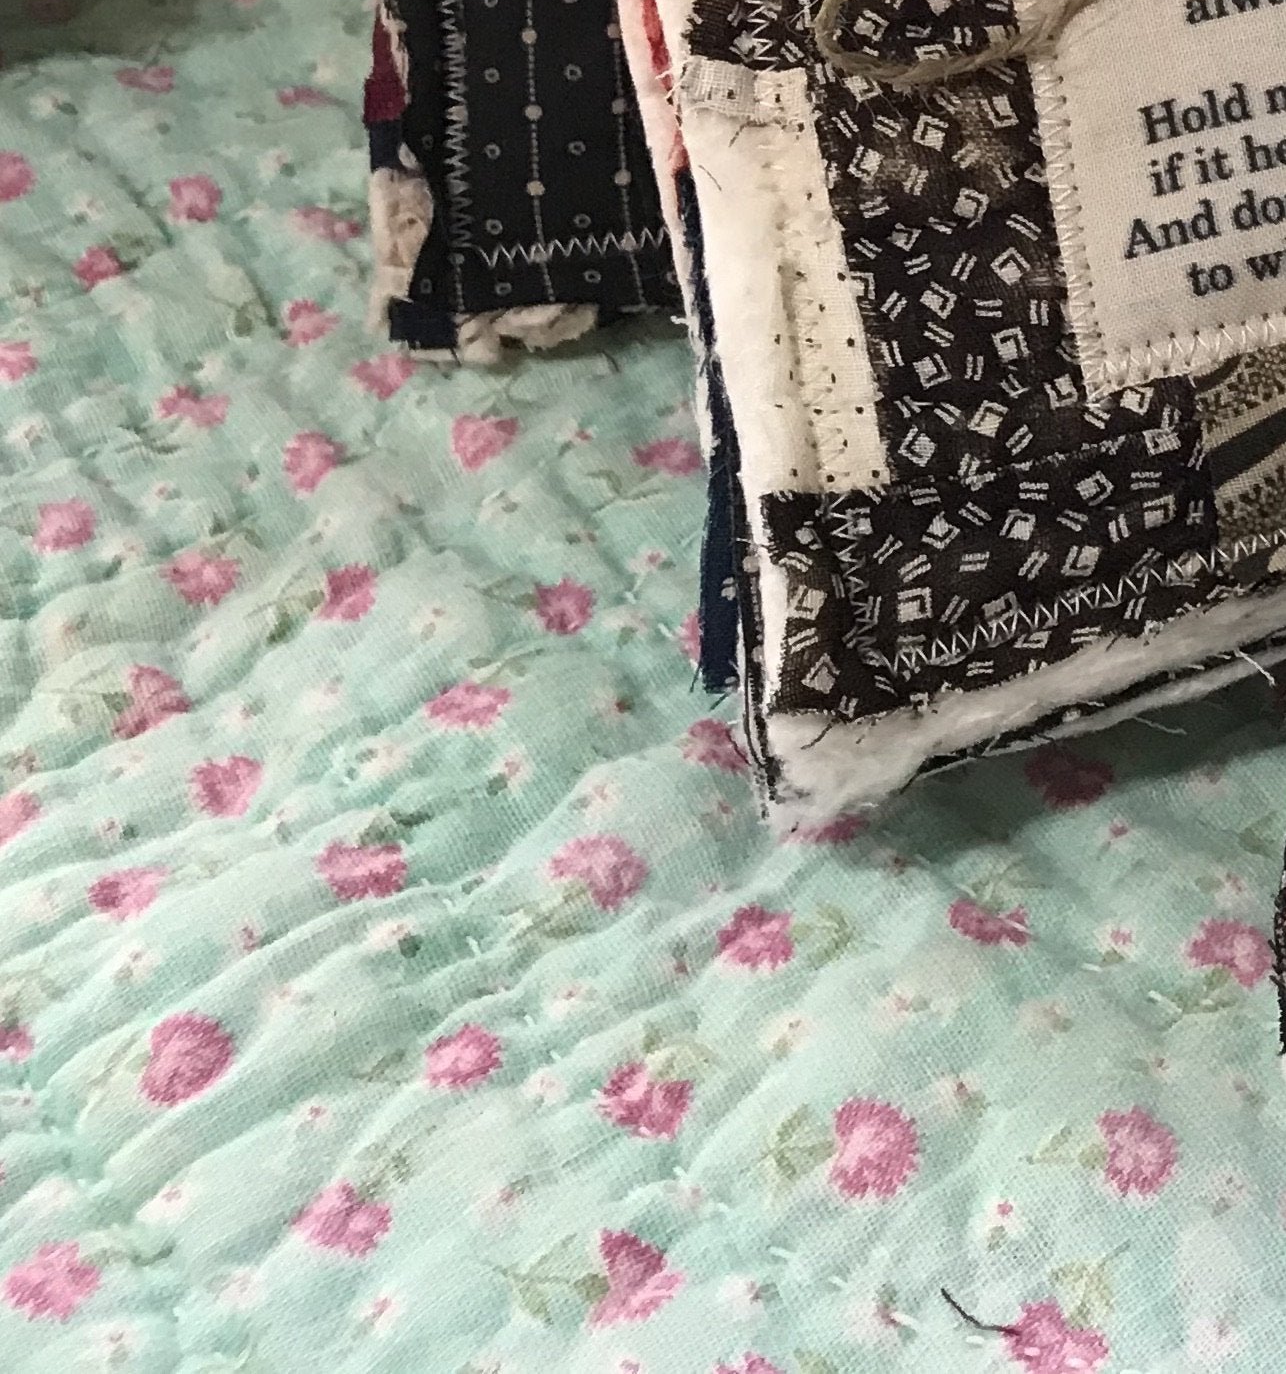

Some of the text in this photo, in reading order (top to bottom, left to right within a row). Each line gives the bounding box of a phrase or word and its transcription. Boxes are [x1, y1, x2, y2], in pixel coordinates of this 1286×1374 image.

[1138, 82, 1252, 145] Hold
[1147, 151, 1185, 197] if
[1194, 146, 1234, 185] it
[1124, 198, 1222, 260] And
[1187, 262, 1235, 297] to
